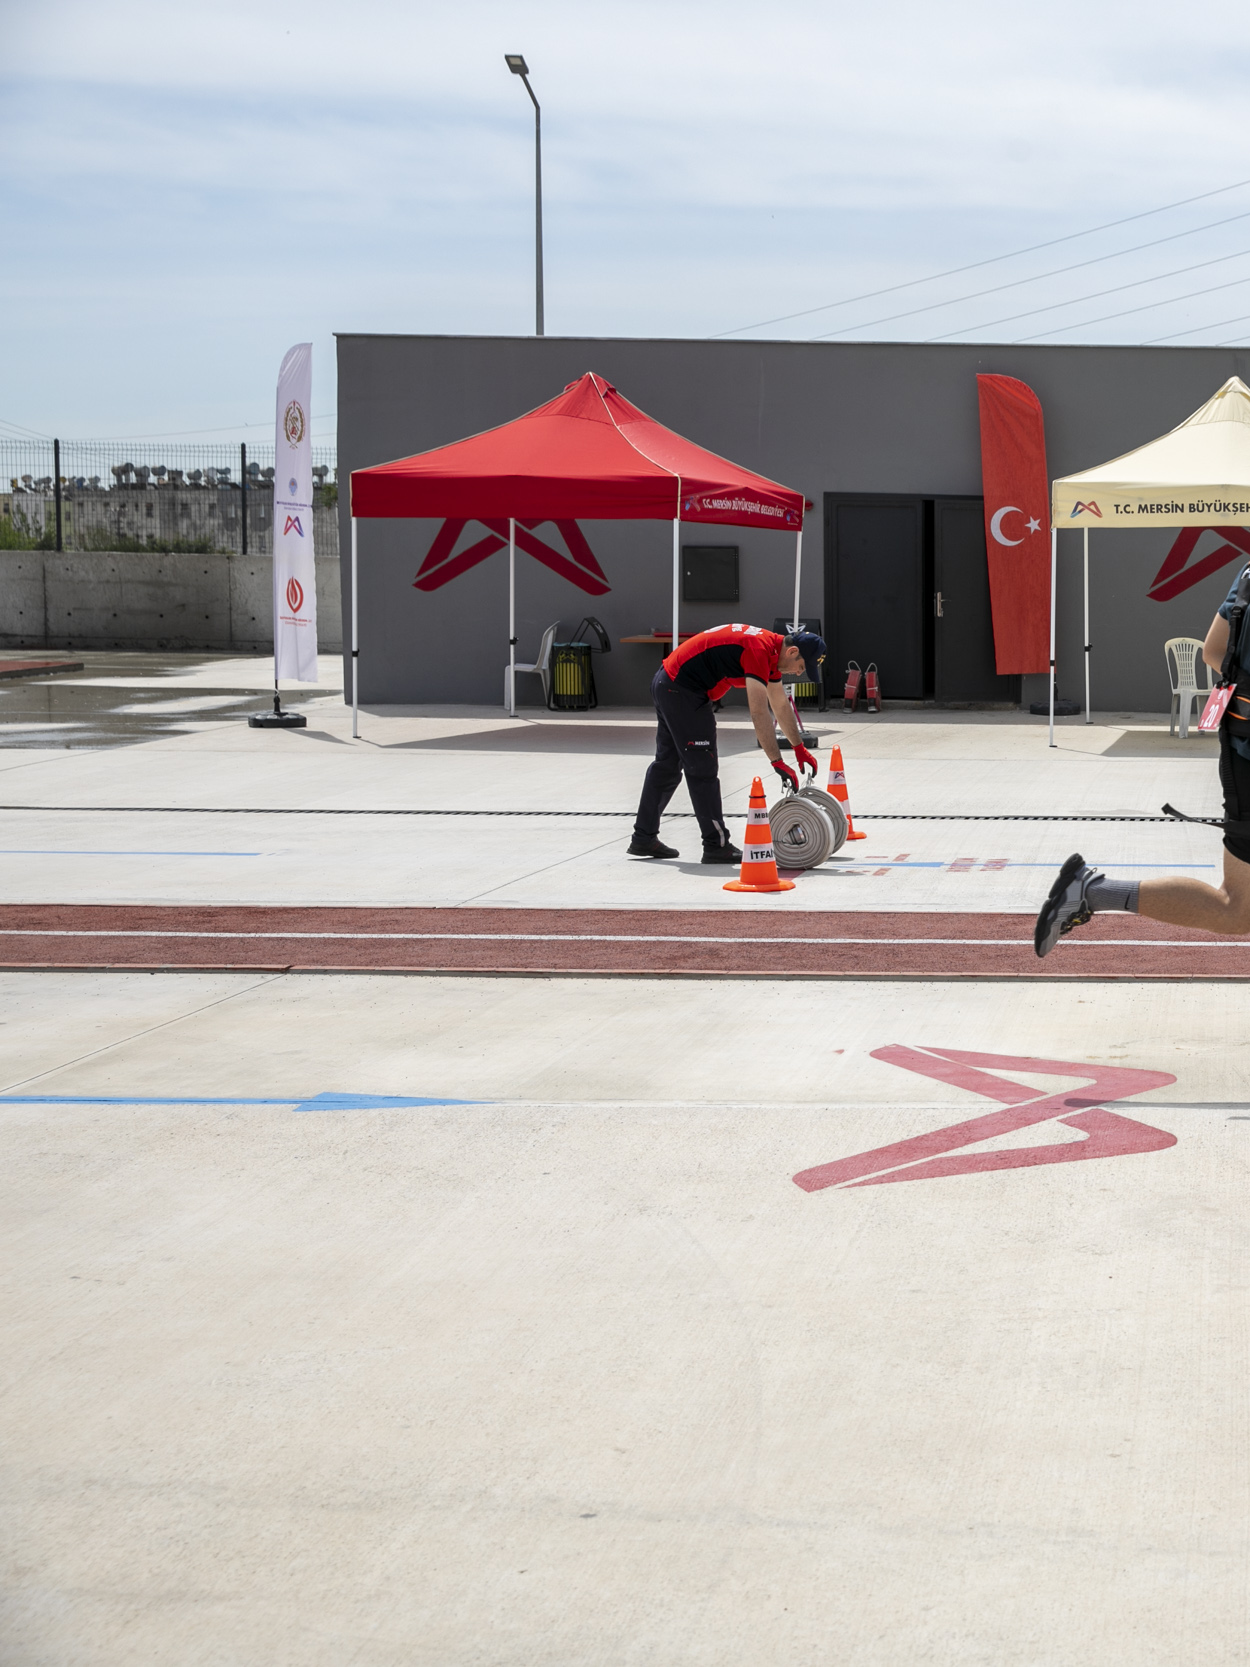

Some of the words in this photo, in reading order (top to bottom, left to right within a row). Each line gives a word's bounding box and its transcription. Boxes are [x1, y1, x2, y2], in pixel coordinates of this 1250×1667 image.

[712, 496, 732, 510] MERSİN
[731, 497, 761, 515] BÜYÜKŞEHİR
[1113, 503, 1135, 515] T.C.
[1137, 500, 1185, 514] MERSİN
[1203, 704, 1220, 728] 20
